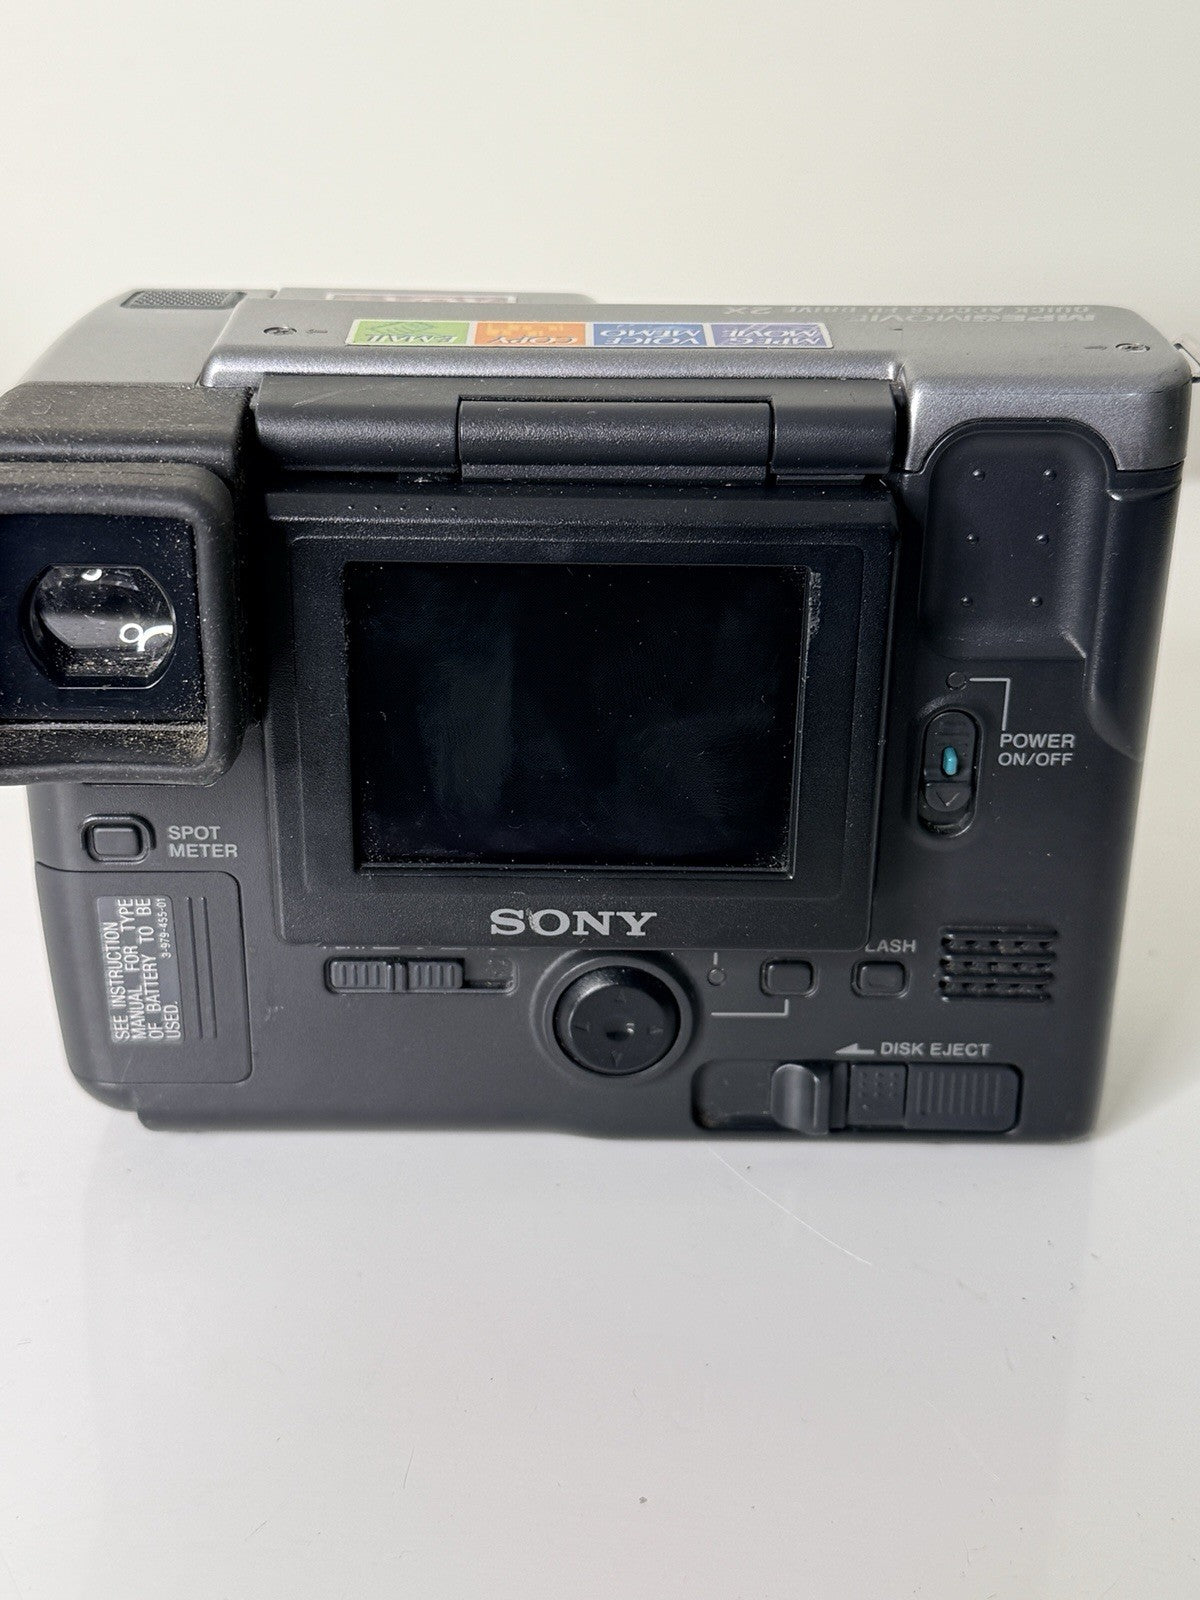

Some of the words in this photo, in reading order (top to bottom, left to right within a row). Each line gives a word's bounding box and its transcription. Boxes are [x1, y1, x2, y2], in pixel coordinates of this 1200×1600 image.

[489, 336, 578, 344] COPY
[600, 330, 701, 338] MEMO
[722, 330, 818, 338] MOVIE
[1000, 733, 1075, 748] POWER
[998, 752, 1073, 766] ON/OFF
[168, 825, 221, 840] SPOT
[169, 843, 238, 858] METER
[118, 898, 135, 932] TYPE
[136, 898, 152, 916] BE
[489, 908, 657, 936] SONY
[138, 926, 154, 944] TO
[865, 939, 917, 953] LASH
[103, 921, 127, 1008] INSTRUCTION
[123, 945, 140, 971] FOR
[142, 953, 162, 1013] BATTERY
[128, 985, 147, 1039] MANUAL
[163, 1001, 181, 1039] USED.
[113, 1015, 130, 1040] SEE
[148, 1022, 164, 1039] OF
[880, 1042, 925, 1056] DISK
[929, 1043, 990, 1056] EJECT
